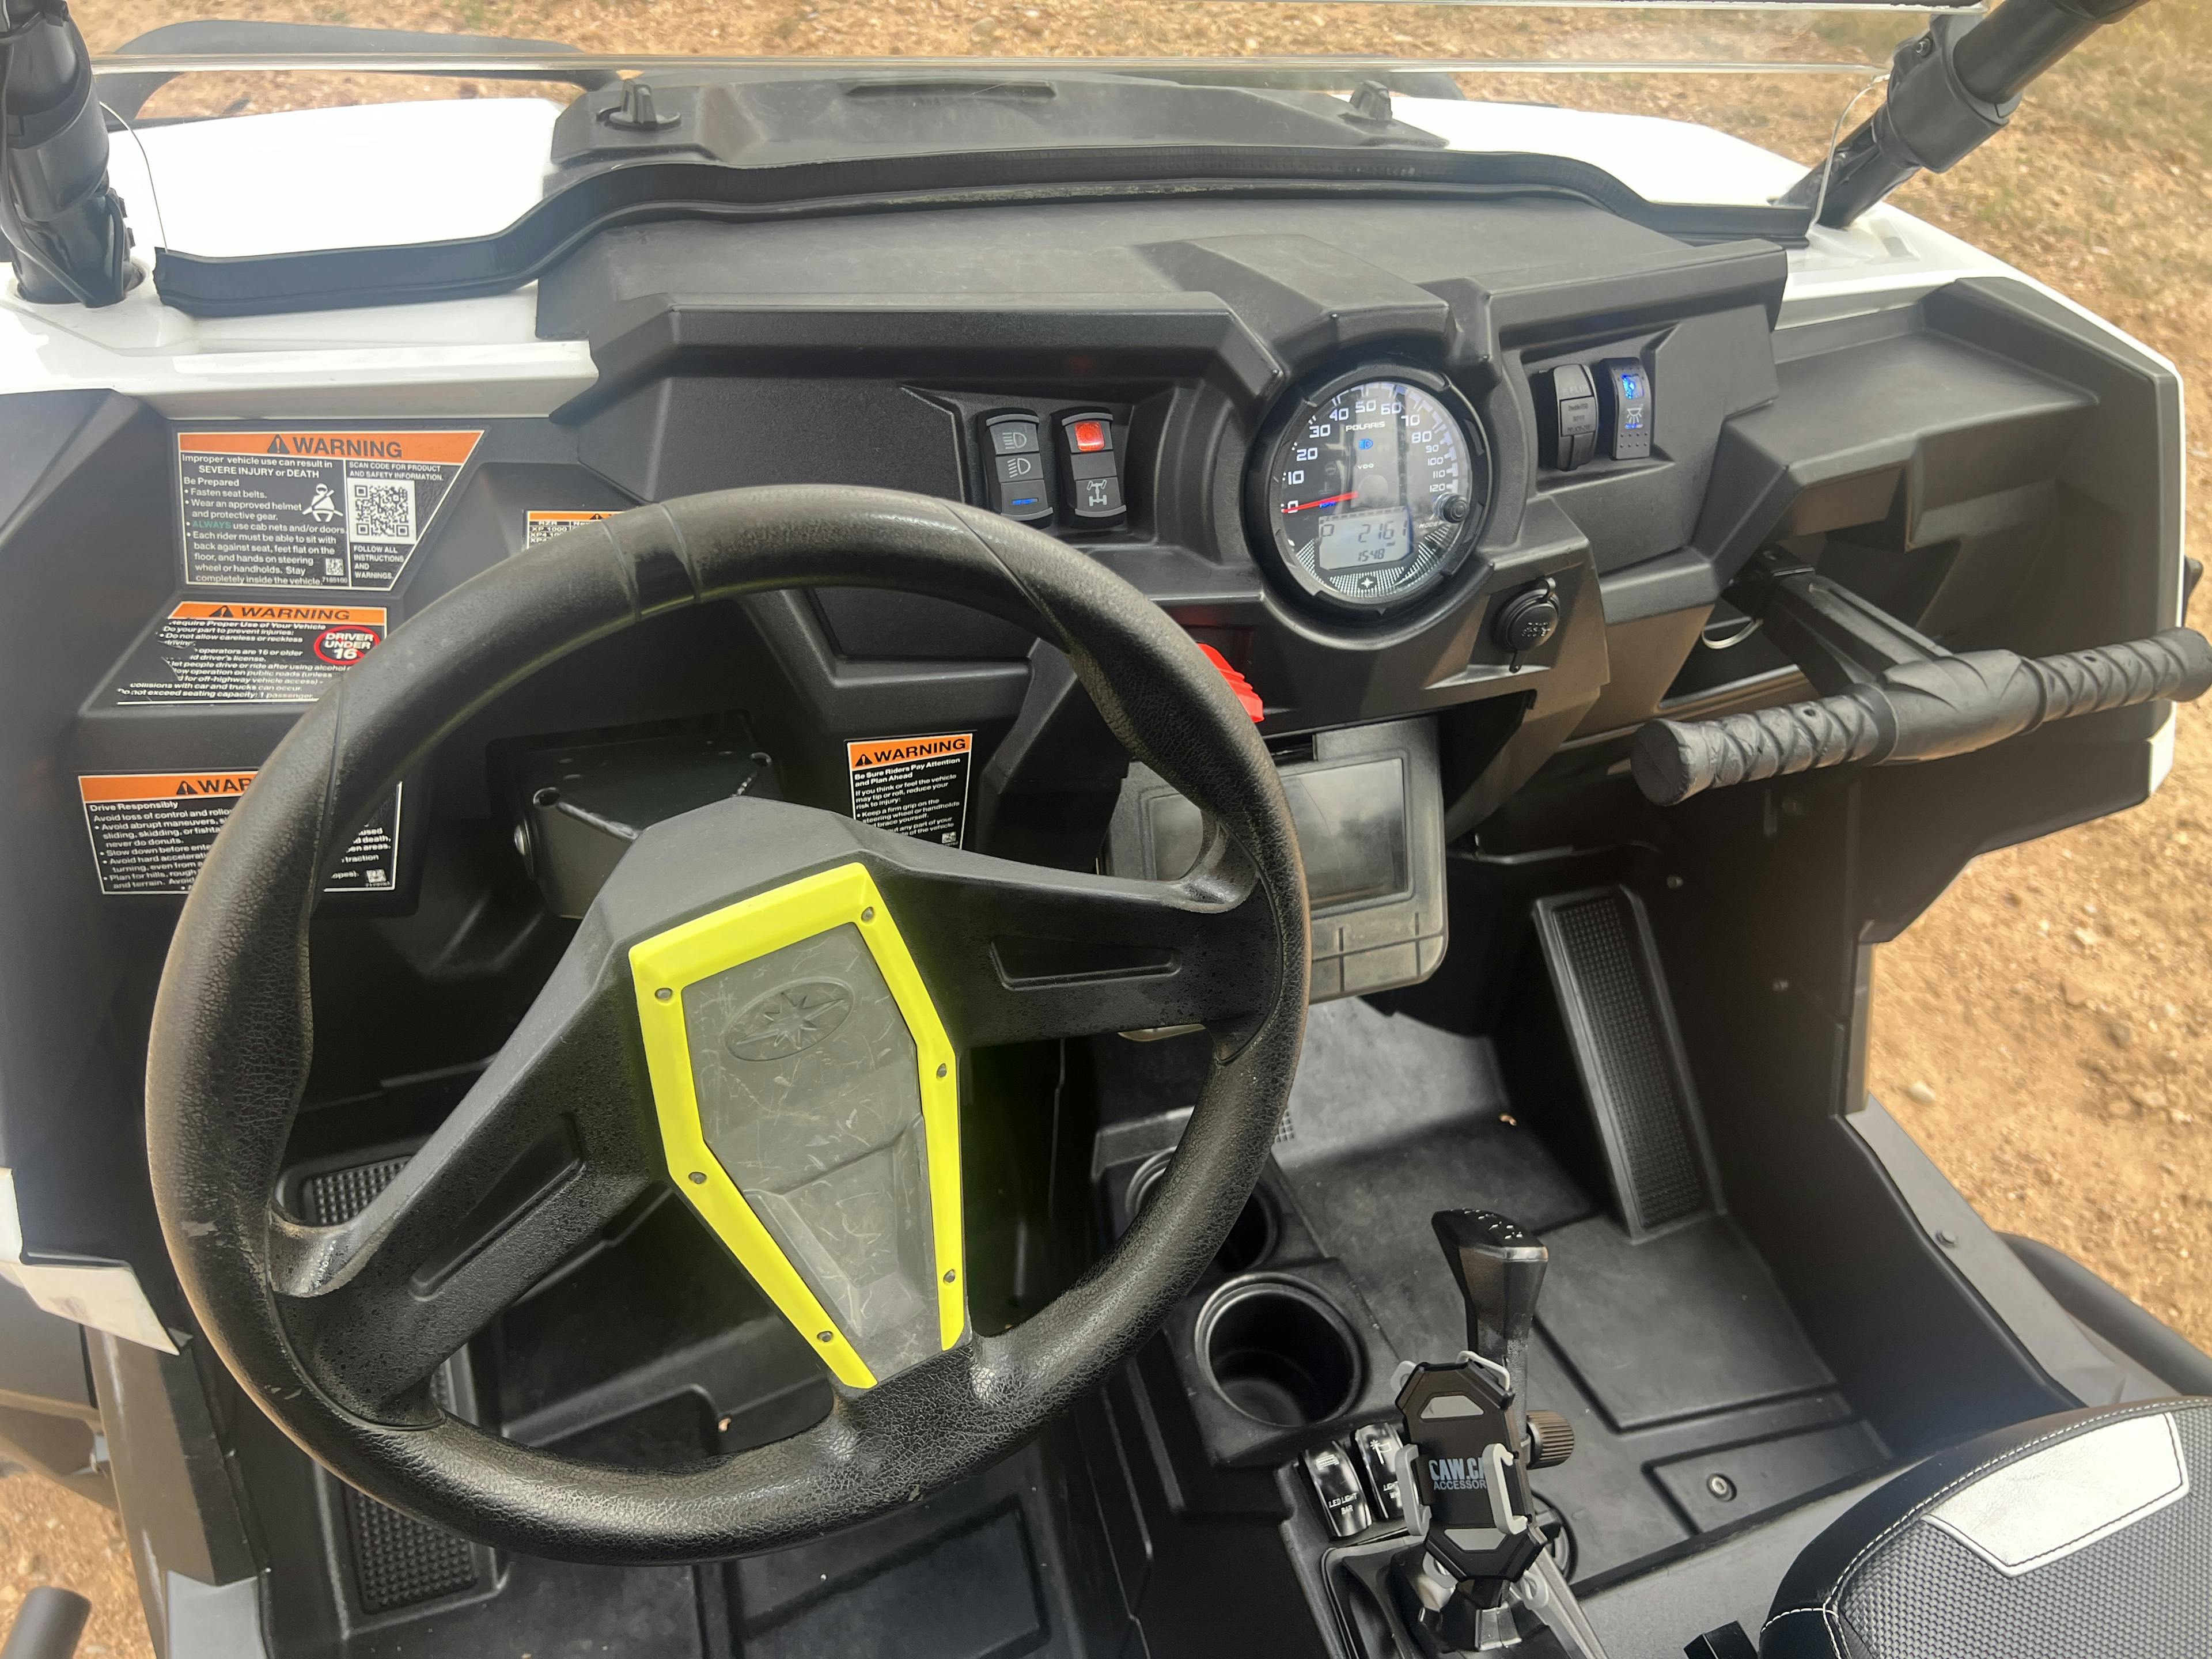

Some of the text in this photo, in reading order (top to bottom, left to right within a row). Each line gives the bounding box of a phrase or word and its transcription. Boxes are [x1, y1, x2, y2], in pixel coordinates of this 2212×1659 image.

[1355, 400, 1376, 414] 50
[1381, 402, 1402, 415] 60
[1329, 408, 1349, 421] 40
[1401, 414, 1420, 427] 70
[1309, 424, 1331, 438] 30
[1345, 421, 1385, 432] POLARIS
[1412, 431, 1432, 444] 80
[293, 437, 402, 458] WARNING
[1426, 444, 1439, 453] 90
[182, 454, 224, 464] Improper
[227, 456, 259, 465] vehicle
[1296, 447, 1318, 461] 20
[1427, 457, 1444, 466] 100
[199, 465, 237, 475] SEVERE
[238, 467, 274, 476] INJURY
[287, 468, 320, 478] DEATH
[407, 464, 441, 472] PRODUCT
[1433, 469, 1445, 479] 110
[184, 476, 240, 487] Be Prepared
[366, 471, 393, 479] SAFETY
[395, 472, 444, 481] INFORMATION.
[1287, 470, 1304, 485] 10
[191, 487, 267, 499] Fasten seat belts.
[1429, 483, 1445, 493] 120
[191, 499, 214, 507] Wear
[228, 501, 271, 510] approved
[272, 502, 302, 511] helmet
[1287, 500, 1298, 513] 0
[211, 511, 255, 520] protective
[256, 513, 278, 521] gear.
[192, 520, 231, 529] ALWAYS
[251, 523, 267, 531] cab
[268, 524, 288, 532] nets
[289, 524, 319, 533] and/or
[1419, 521, 1438, 529] MODE
[193, 531, 336, 544] Each rider must be able to sit with
[194, 541, 215, 550] back
[217, 543, 249, 553] against
[251, 544, 273, 553] seat,
[275, 544, 291, 553] feet
[293, 546, 306, 554] flat
[321, 546, 335, 555] the
[354, 545, 382, 553] FOLLOW
[195, 552, 217, 562] floor,
[218, 554, 235, 562] and
[236, 554, 264, 563] hands
[278, 555, 314, 566] steering
[354, 554, 404, 563] INSTRUCTIONS
[195, 563, 221, 572] wheel
[233, 565, 283, 574] handholds.
[286, 566, 306, 576] Stay
[196, 575, 245, 584] completely
[247, 575, 272, 584] inside
[274, 576, 288, 584] the
[289, 577, 323, 585] vehicle.
[241, 607, 350, 620] WARNING
[325, 632, 374, 642] DRIVER
[324, 640, 372, 649] UNDER
[334, 648, 358, 660] 16
[183, 690, 215, 698] seating
[874, 738, 966, 762] WARNING
[885, 767, 910, 775] Riders
[926, 757, 960, 768] Attention
[870, 777, 887, 785] Plan
[888, 772, 913, 782] Ahead
[197, 778, 252, 793] WAR
[117, 800, 178, 811] Responsibly
[94, 814, 121, 822] Avoid
[154, 810, 188, 819] control
[190, 809, 207, 817] and
[102, 823, 129, 831] Avoid
[130, 821, 162, 829] abrupt
[1429, 1457, 1484, 1480] CAW.CA
[1434, 1479, 1486, 1490] ACCESSOR
[1328, 1492, 1358, 1508] LED LIGHT
[1341, 1504, 1354, 1515] BAR
